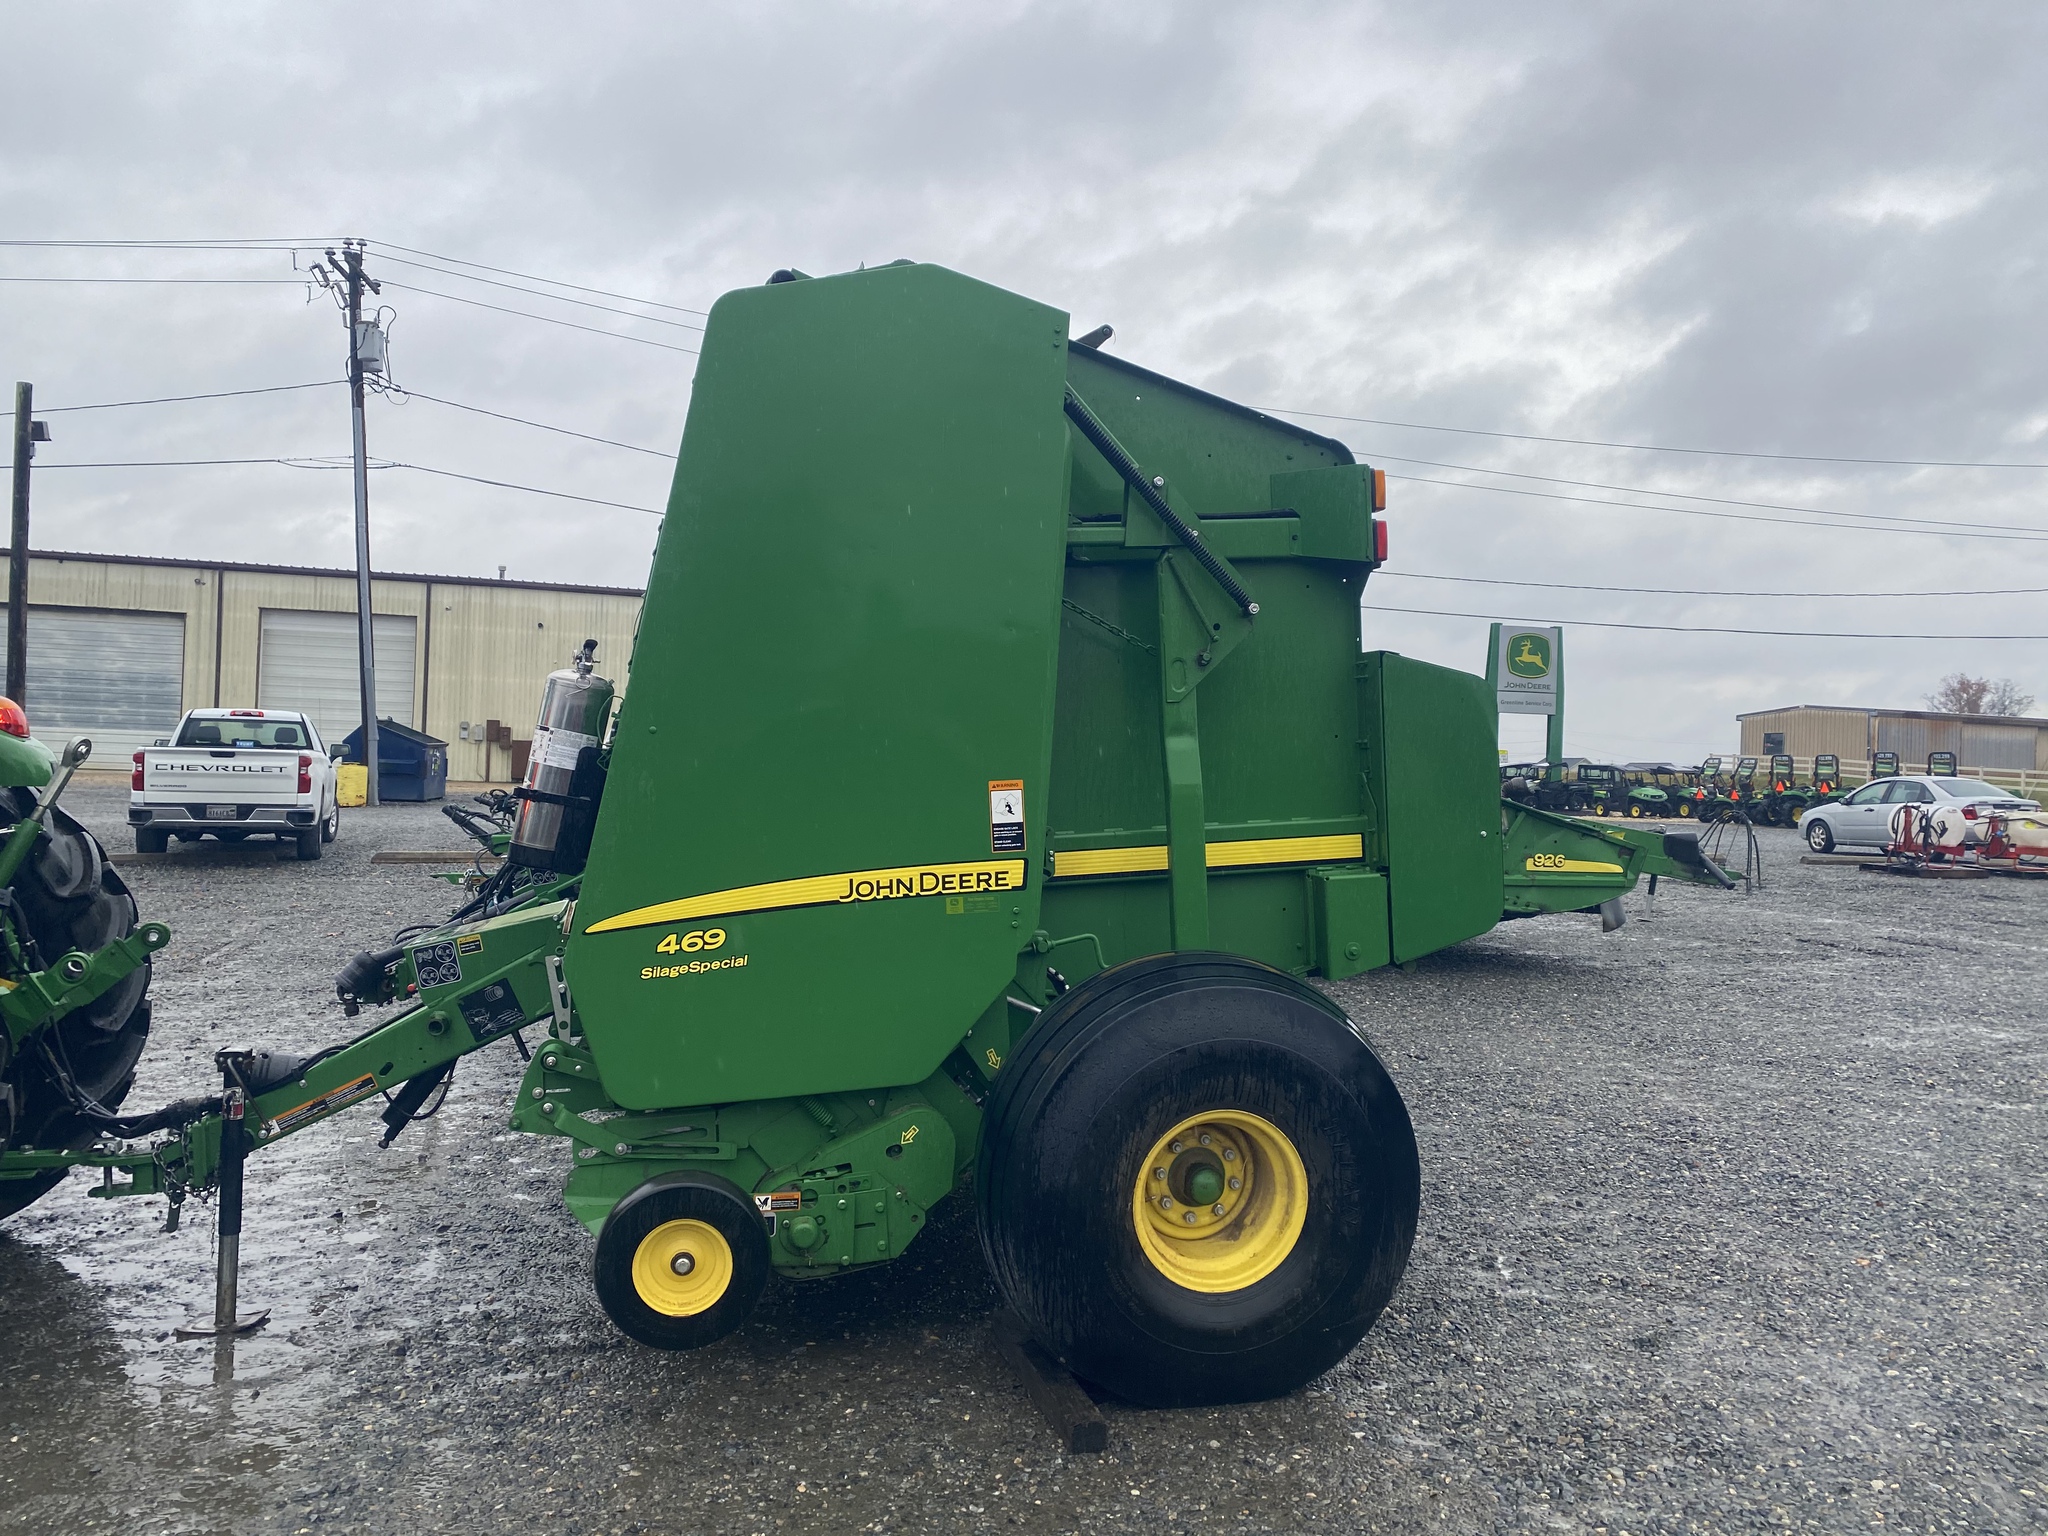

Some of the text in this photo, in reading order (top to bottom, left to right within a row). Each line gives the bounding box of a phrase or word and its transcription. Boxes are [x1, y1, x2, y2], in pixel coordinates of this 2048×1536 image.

[1527, 682, 1551, 690] DEERE
[155, 763, 287, 773] CHEVROLET
[1533, 853, 1566, 868] 926
[839, 871, 1010, 900] JOHN DEERE
[656, 928, 727, 955] 469
[640, 955, 749, 980] SilageSpecial
